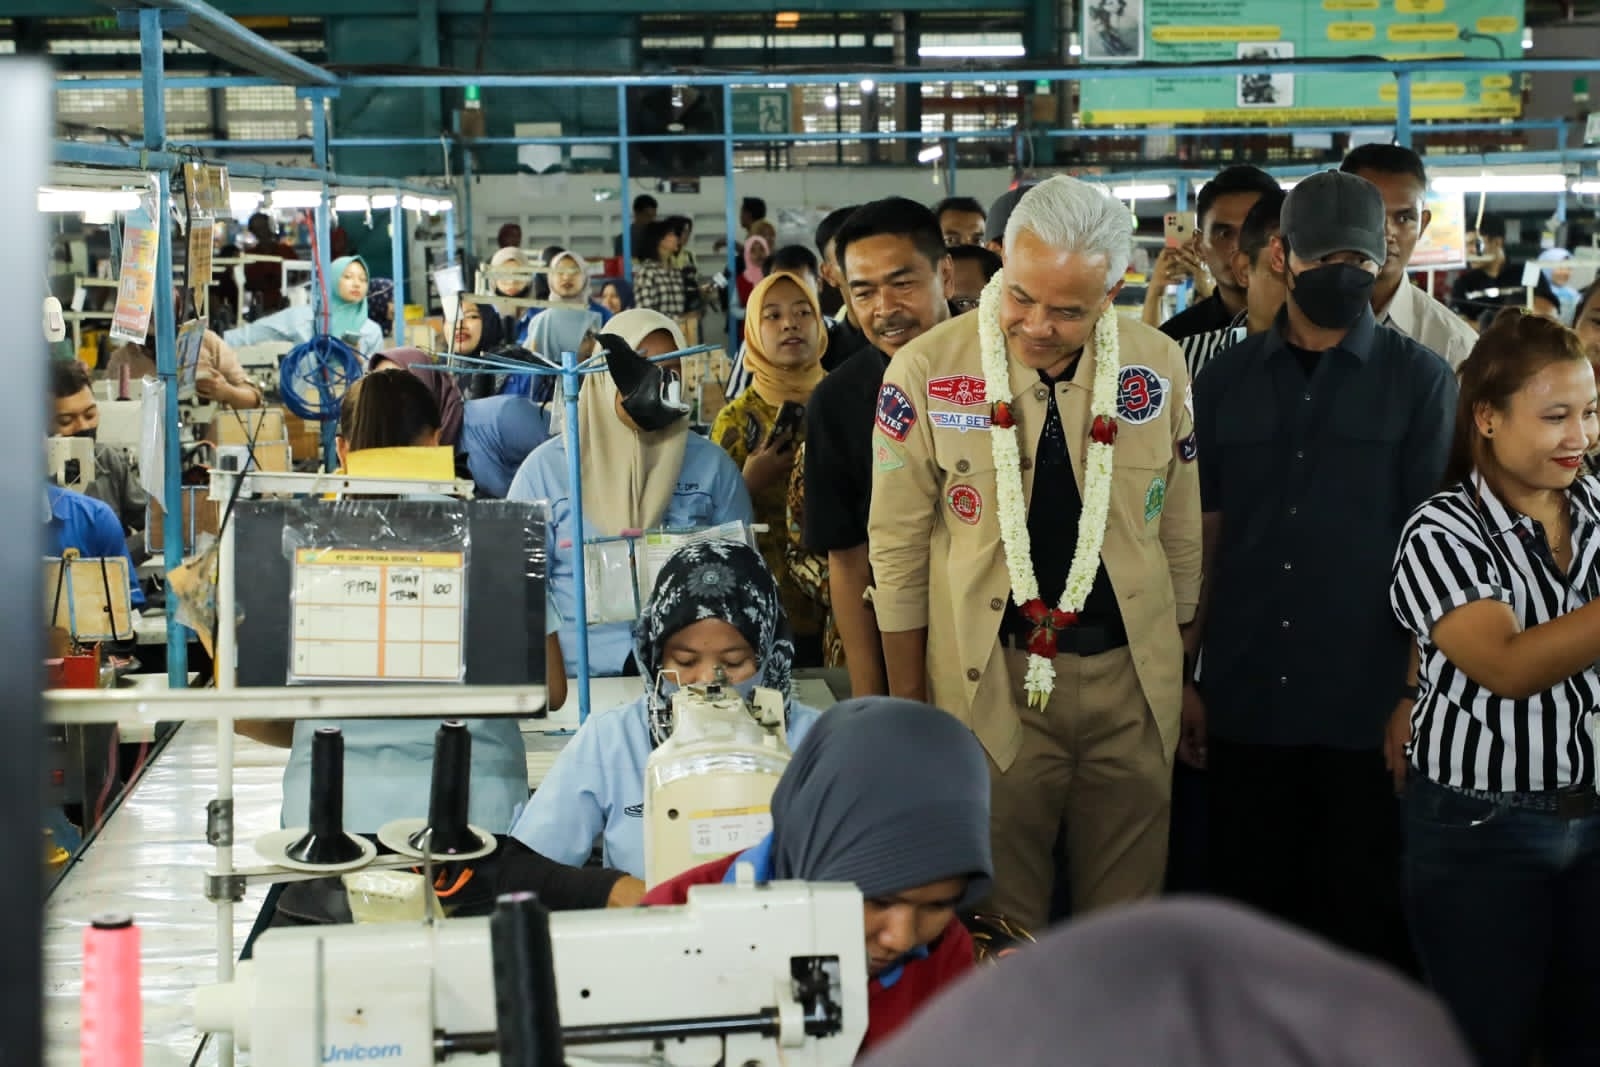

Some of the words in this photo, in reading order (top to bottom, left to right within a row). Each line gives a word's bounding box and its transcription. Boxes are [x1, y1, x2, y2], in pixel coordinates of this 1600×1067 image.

[882, 385, 896, 397] SAT
[893, 391, 911, 409] SET
[1122, 375, 1150, 412] 3
[942, 413, 961, 425] SAT
[966, 415, 989, 426] SET
[320, 1042, 402, 1063] Unicorn
